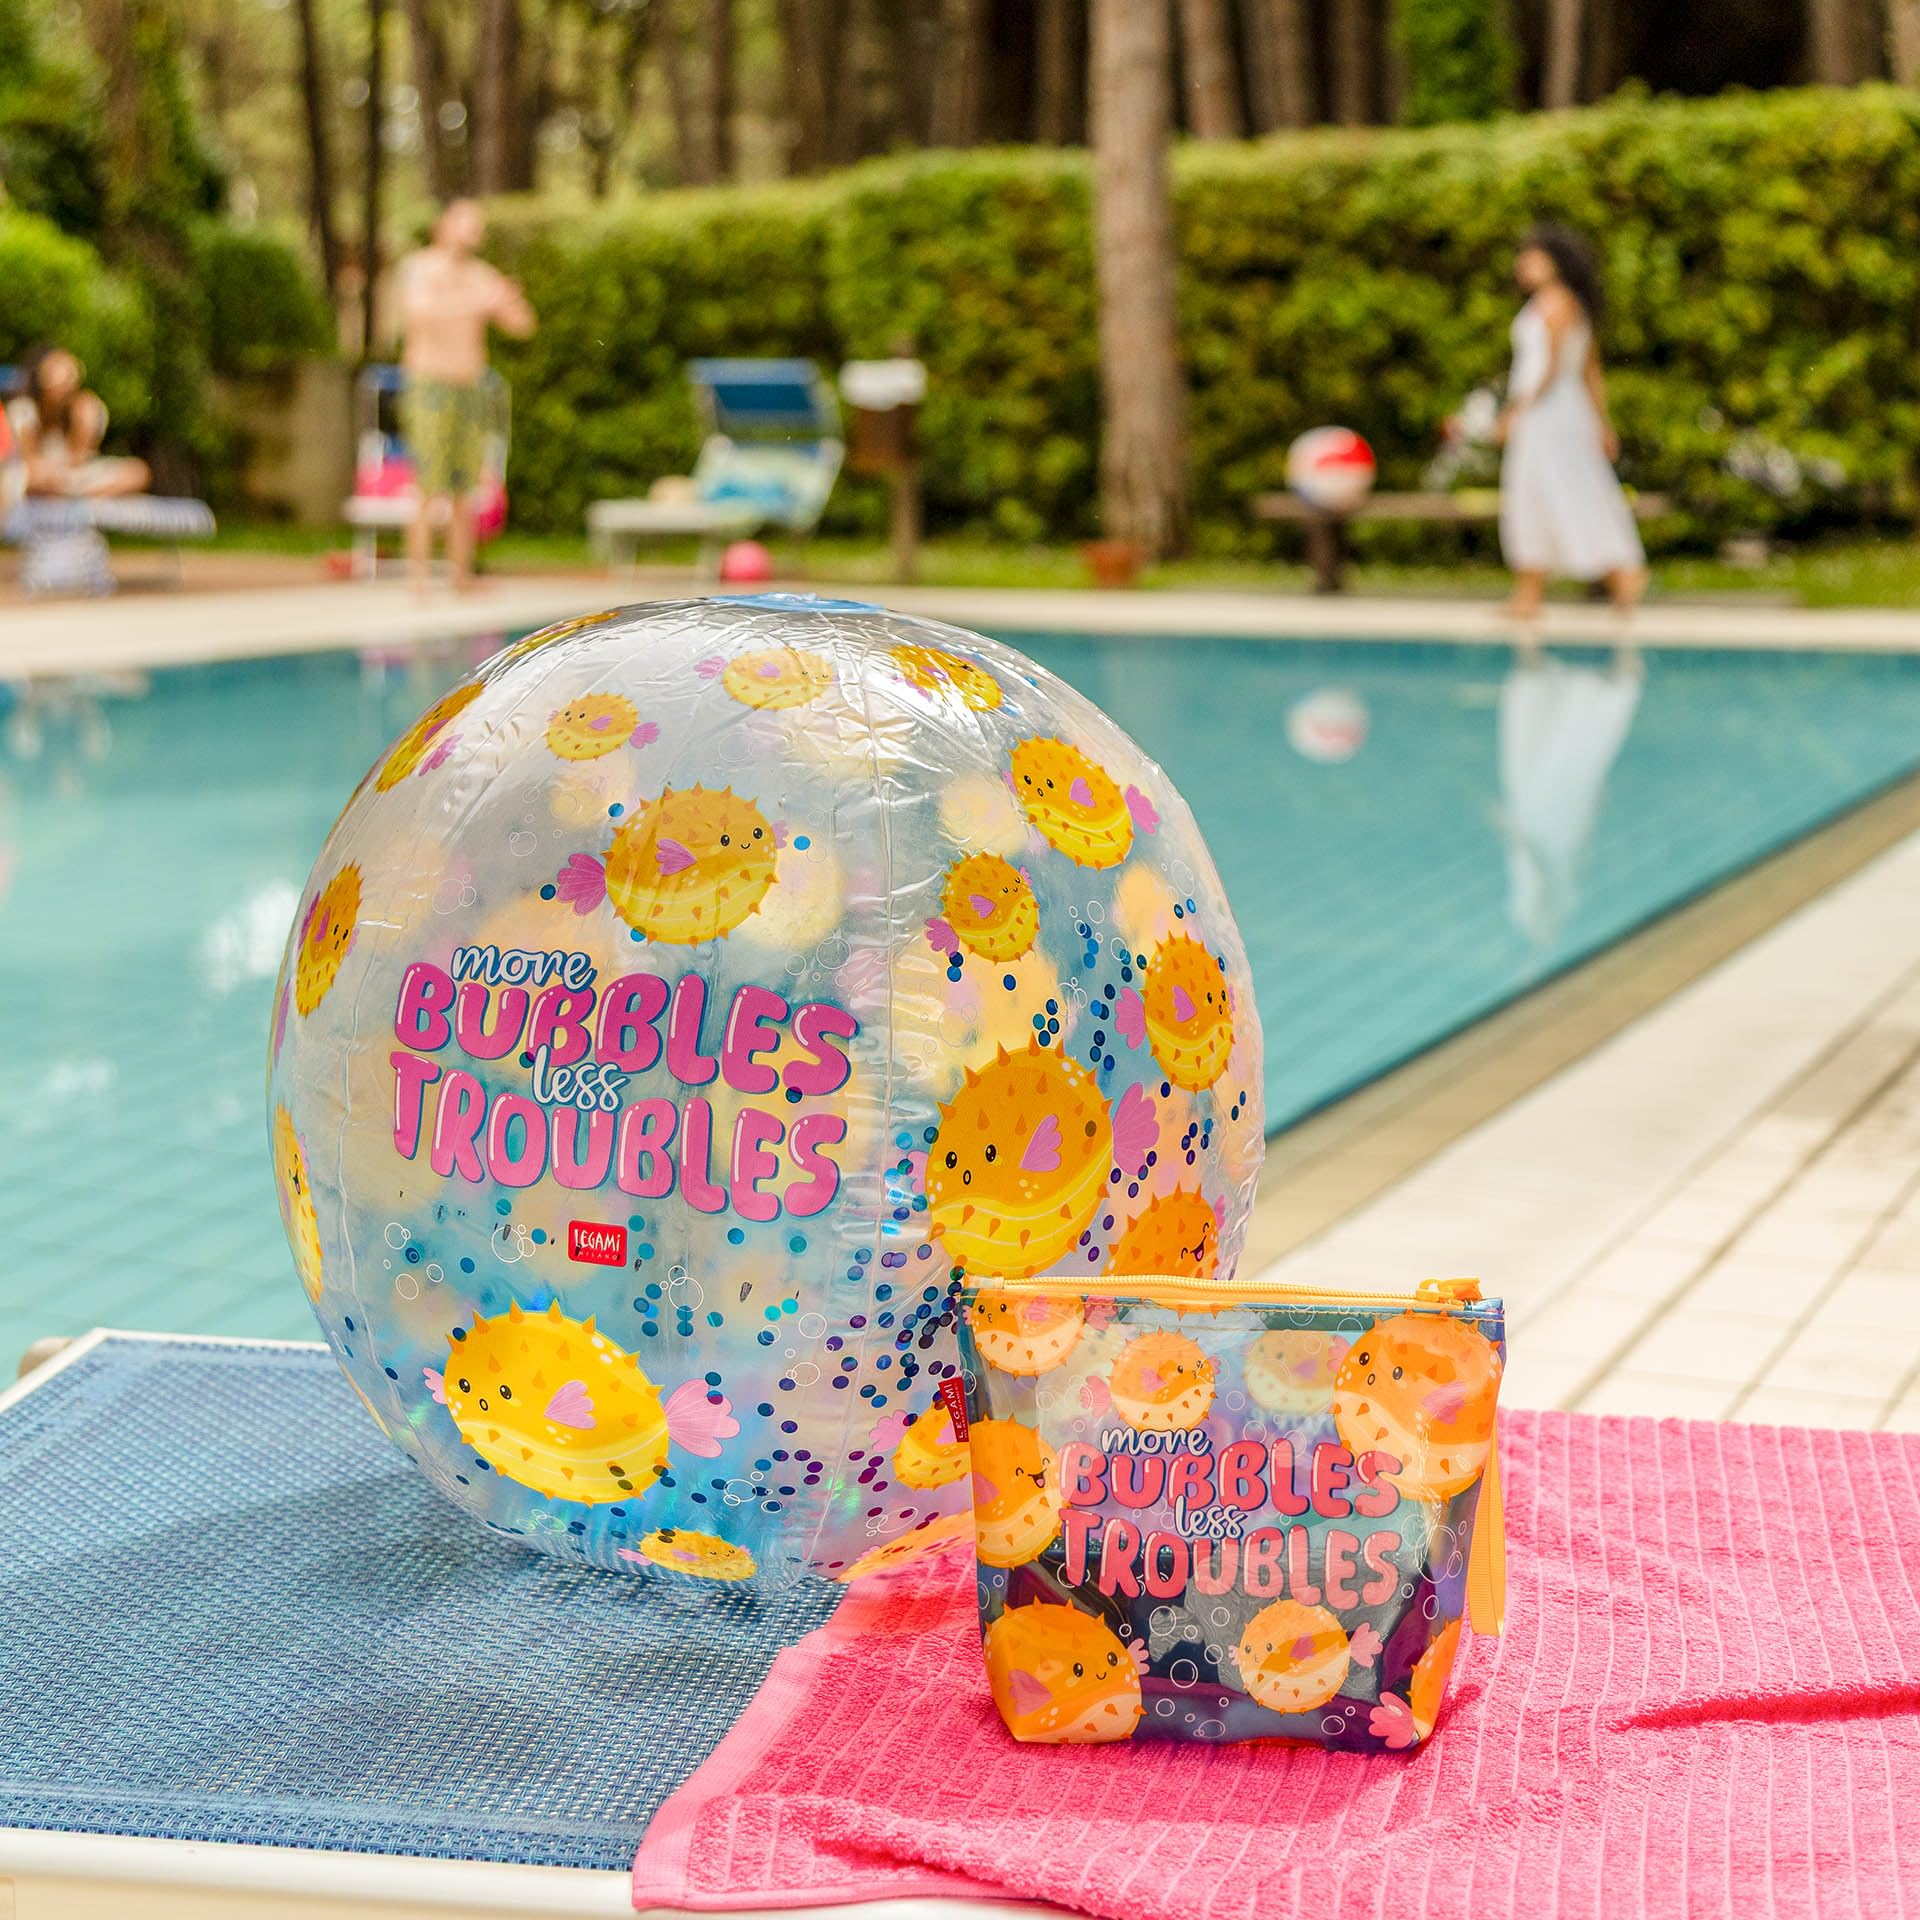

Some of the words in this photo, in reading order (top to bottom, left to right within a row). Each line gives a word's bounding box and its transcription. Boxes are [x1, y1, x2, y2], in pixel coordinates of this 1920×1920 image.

[452, 945, 598, 992] more
[394, 961, 859, 1097] BUBBLES
[533, 1044, 630, 1113] less
[390, 1050, 848, 1222] TROUBLES
[943, 1382, 965, 1439] LEGAMI
[1101, 1427, 1212, 1457] more
[1059, 1438, 1403, 1519] BUBBLES
[1174, 1495, 1248, 1540] less
[1058, 1508, 1402, 1611] TROUBLES
